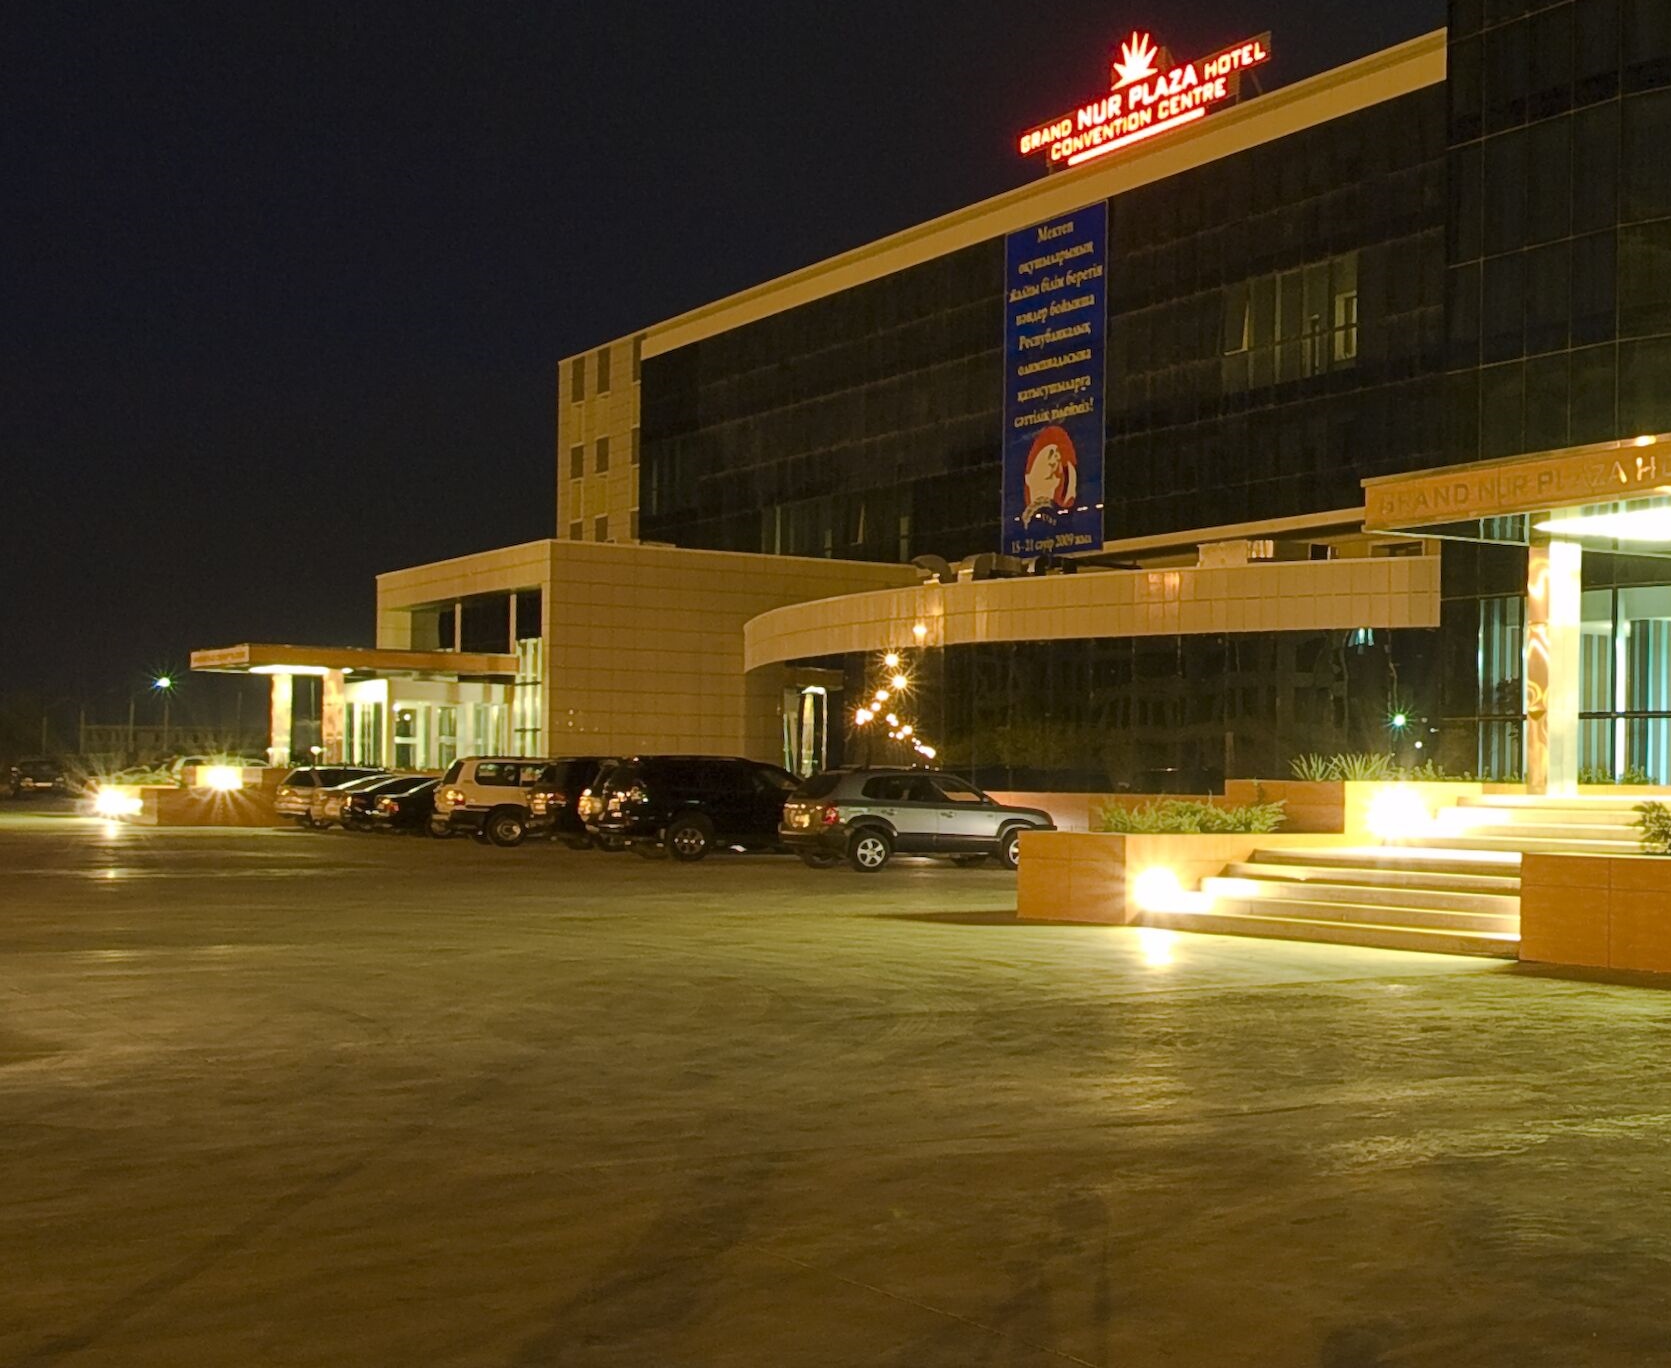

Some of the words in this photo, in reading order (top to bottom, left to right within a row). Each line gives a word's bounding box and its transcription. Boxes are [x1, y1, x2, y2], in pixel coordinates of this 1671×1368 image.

[1020, 119, 1072, 154] GRAND
[1077, 94, 1121, 129] NUR
[1129, 64, 1198, 110] PLAZA
[1204, 42, 1266, 80] HOTEL
[1050, 107, 1152, 161] CONVENTION
[1157, 77, 1226, 119] CENTRE
[1037, 221, 1074, 243] Мектеп
[1066, 263, 1103, 287] беретін
[1478, 475, 1527, 503] NUR
